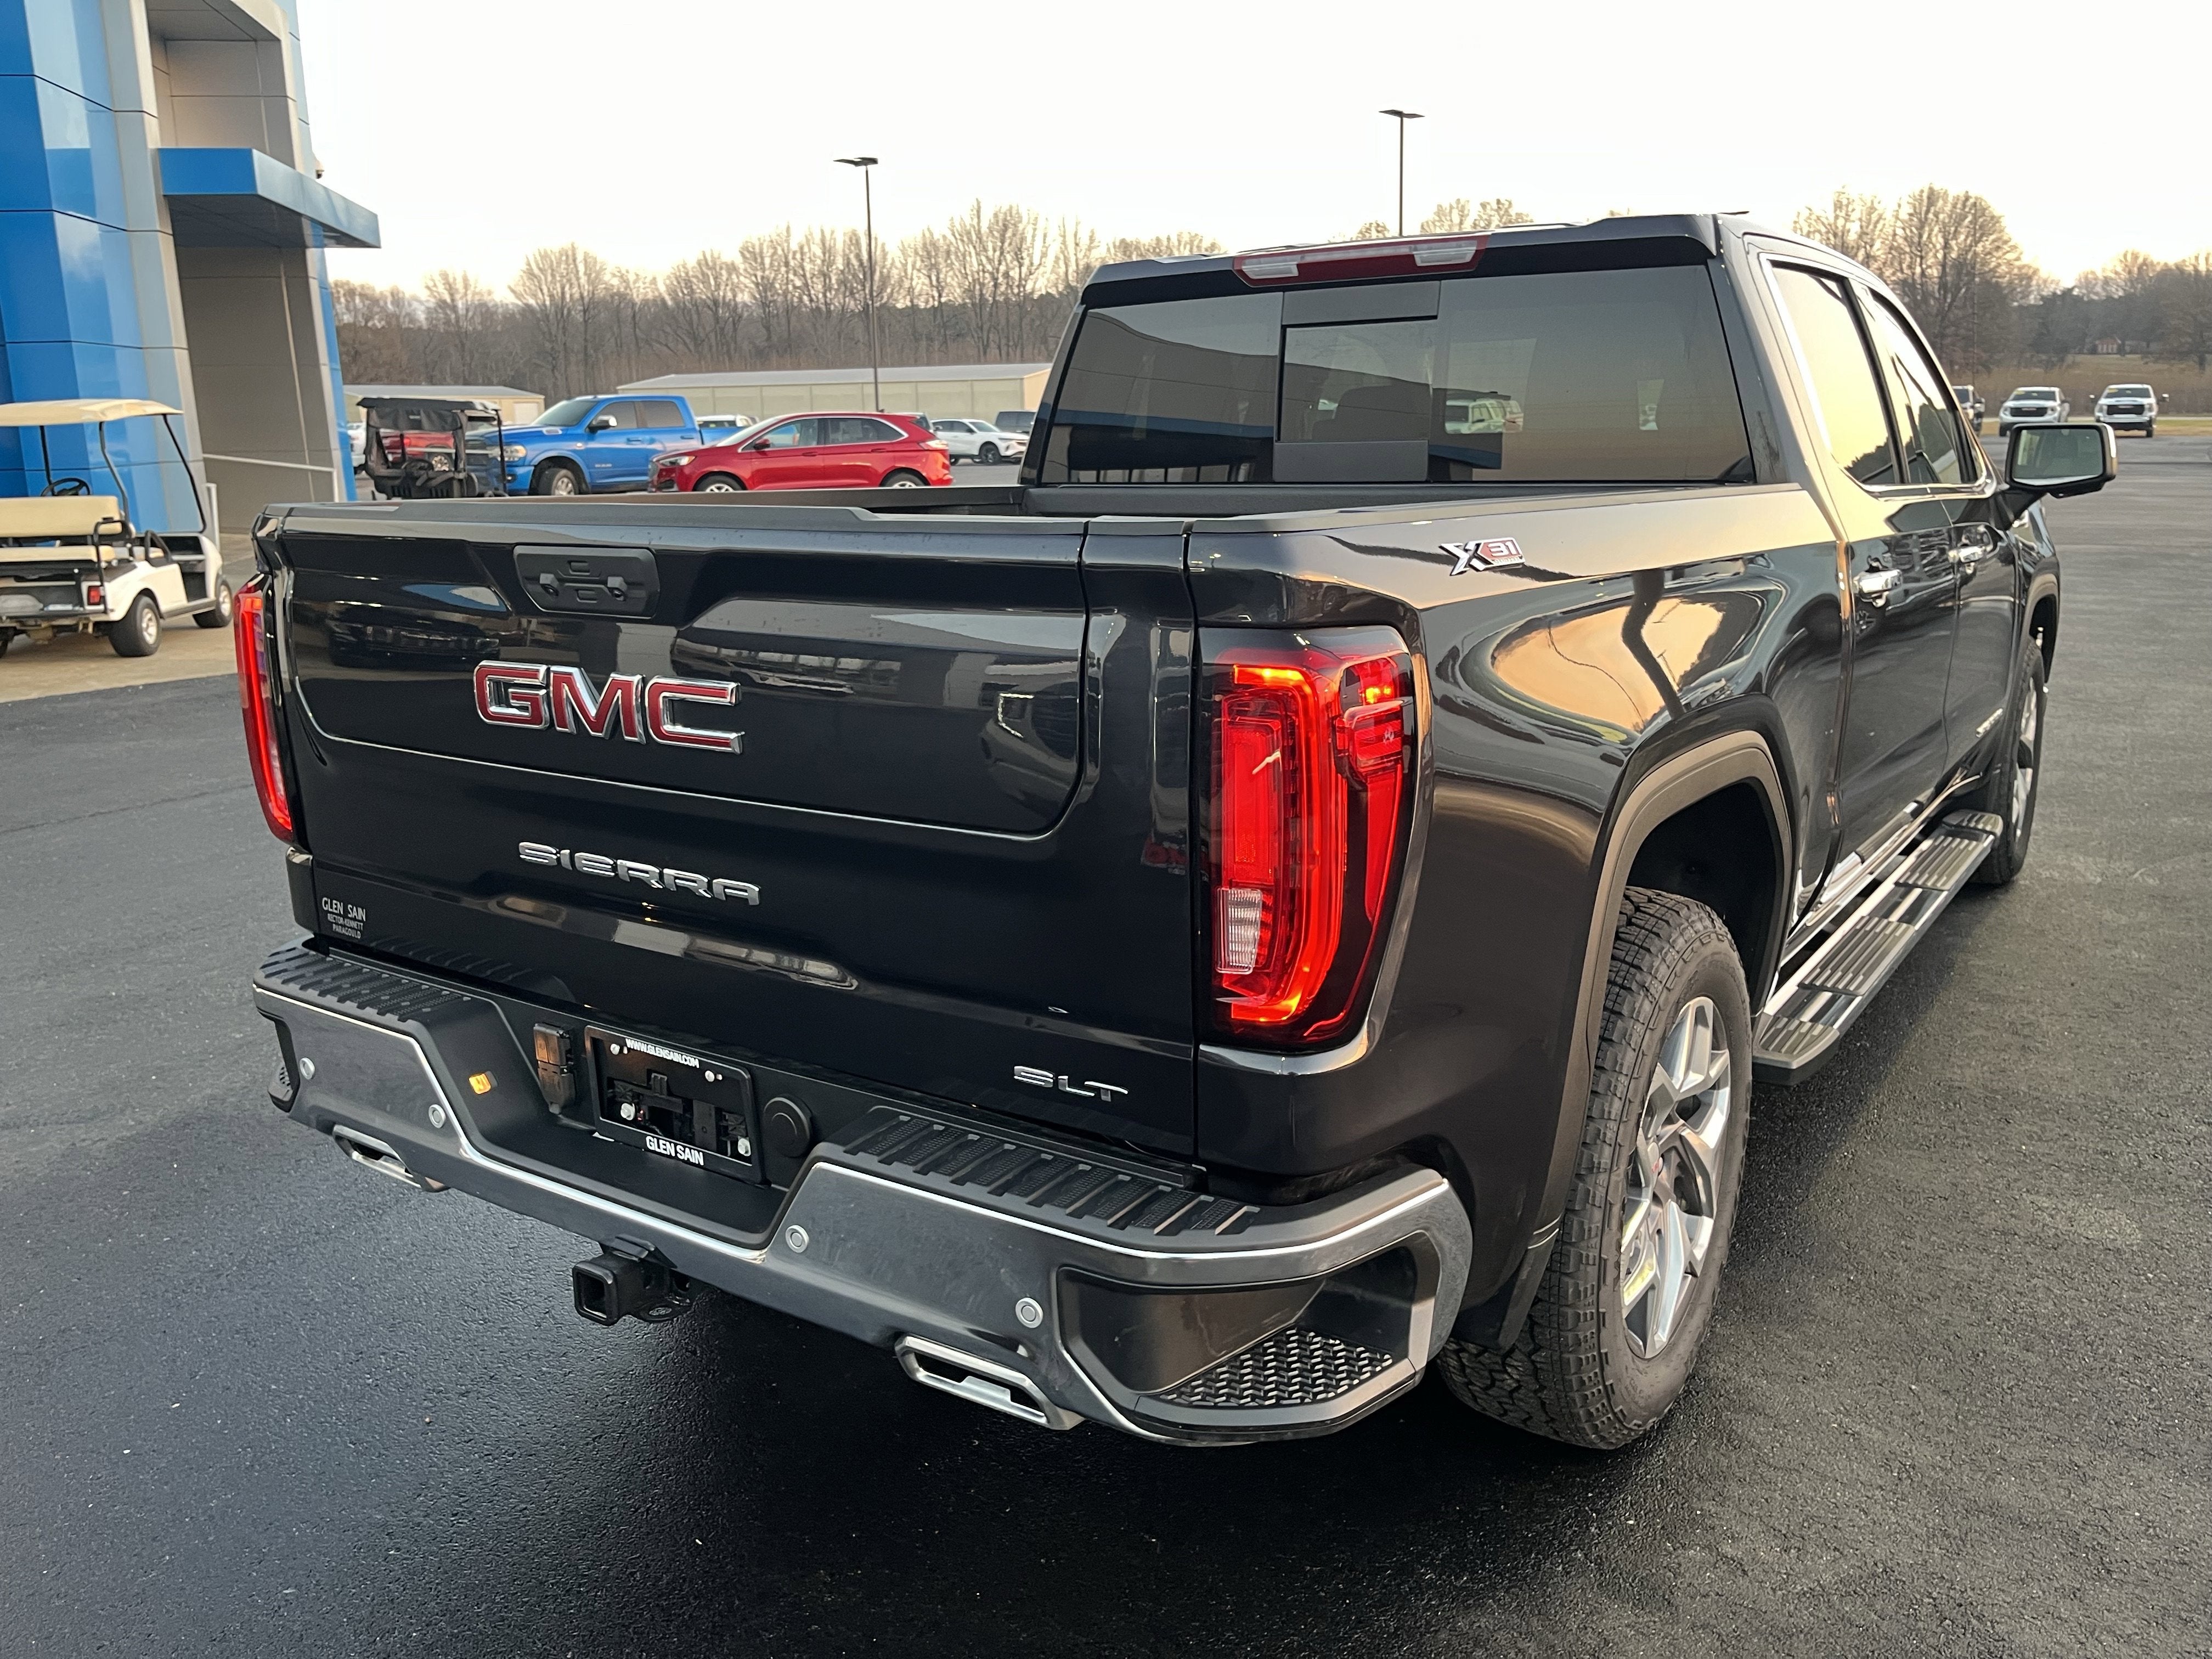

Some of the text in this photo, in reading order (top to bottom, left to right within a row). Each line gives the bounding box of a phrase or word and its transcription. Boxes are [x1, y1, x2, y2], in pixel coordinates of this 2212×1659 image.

[1438, 537, 1523, 576] X31
[473, 659, 744, 755] GMC
[518, 842, 761, 906] SIERRA
[322, 897, 366, 922] GLEN SAIN
[332, 923, 361, 939] PARAGOULD
[625, 1038, 700, 1069] WWW.GLENSAIN.COM
[1014, 1065, 1128, 1102] SLT
[646, 1136, 704, 1166] GLEN SAIN
